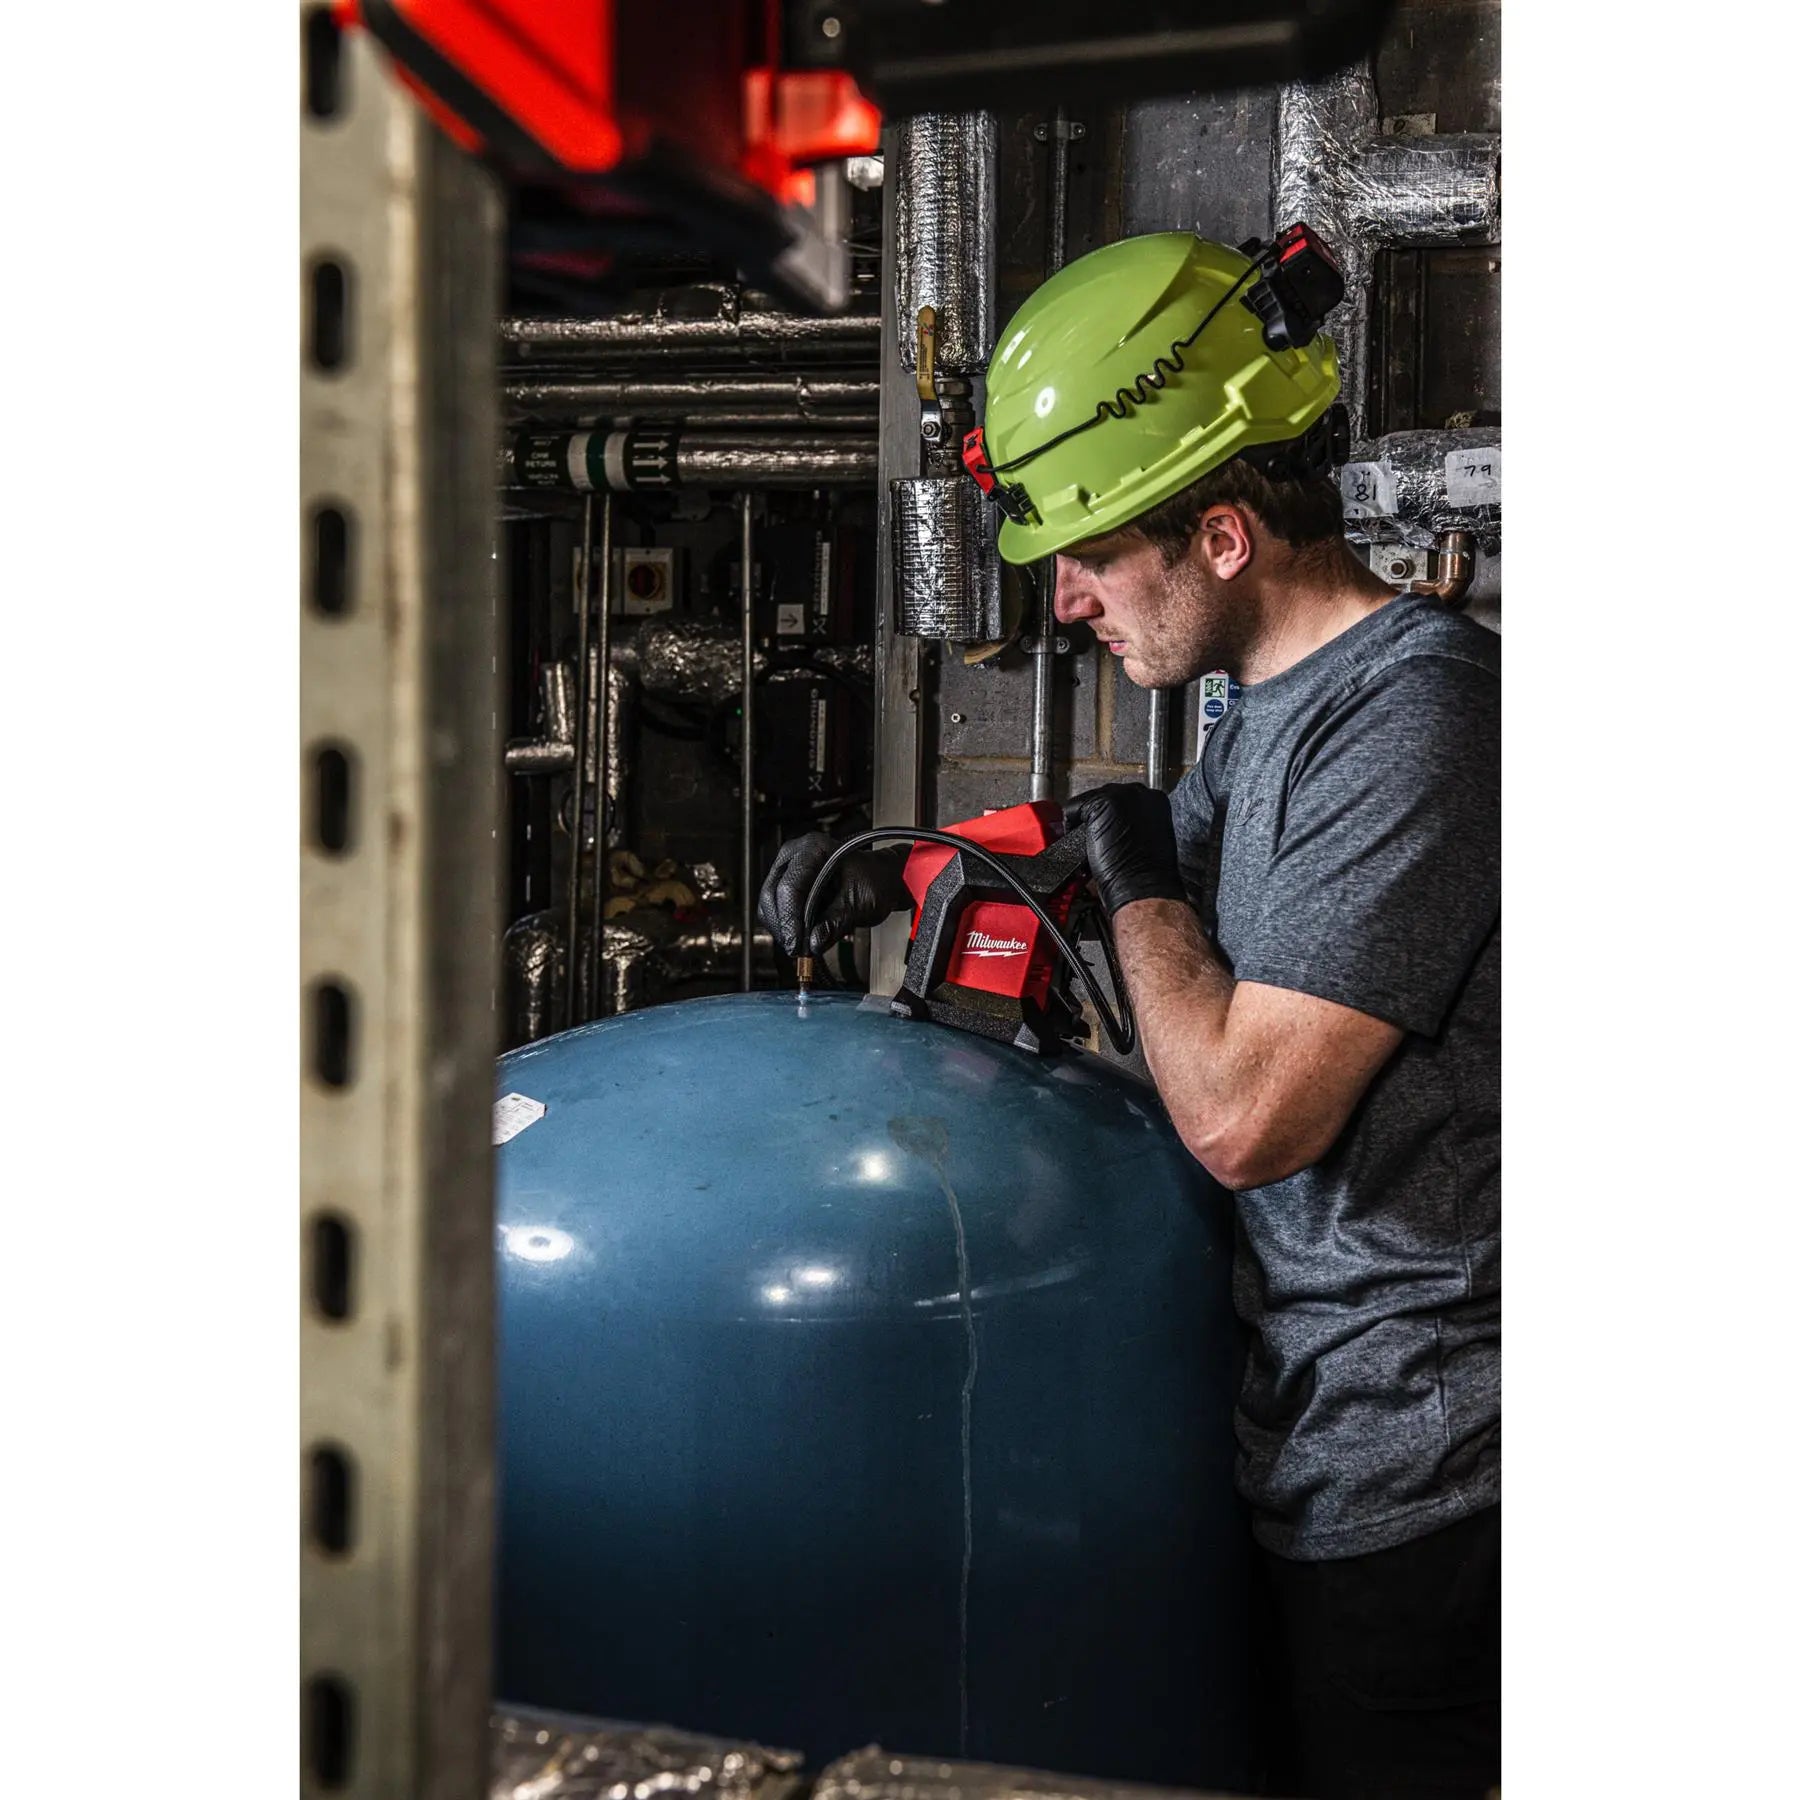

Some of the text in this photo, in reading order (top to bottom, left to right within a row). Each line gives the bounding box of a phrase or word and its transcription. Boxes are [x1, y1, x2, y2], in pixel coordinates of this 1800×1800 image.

[1464, 464, 1492, 478] 79
[1355, 483, 1377, 502] 81
[966, 930, 1028, 950] Milwaukee
